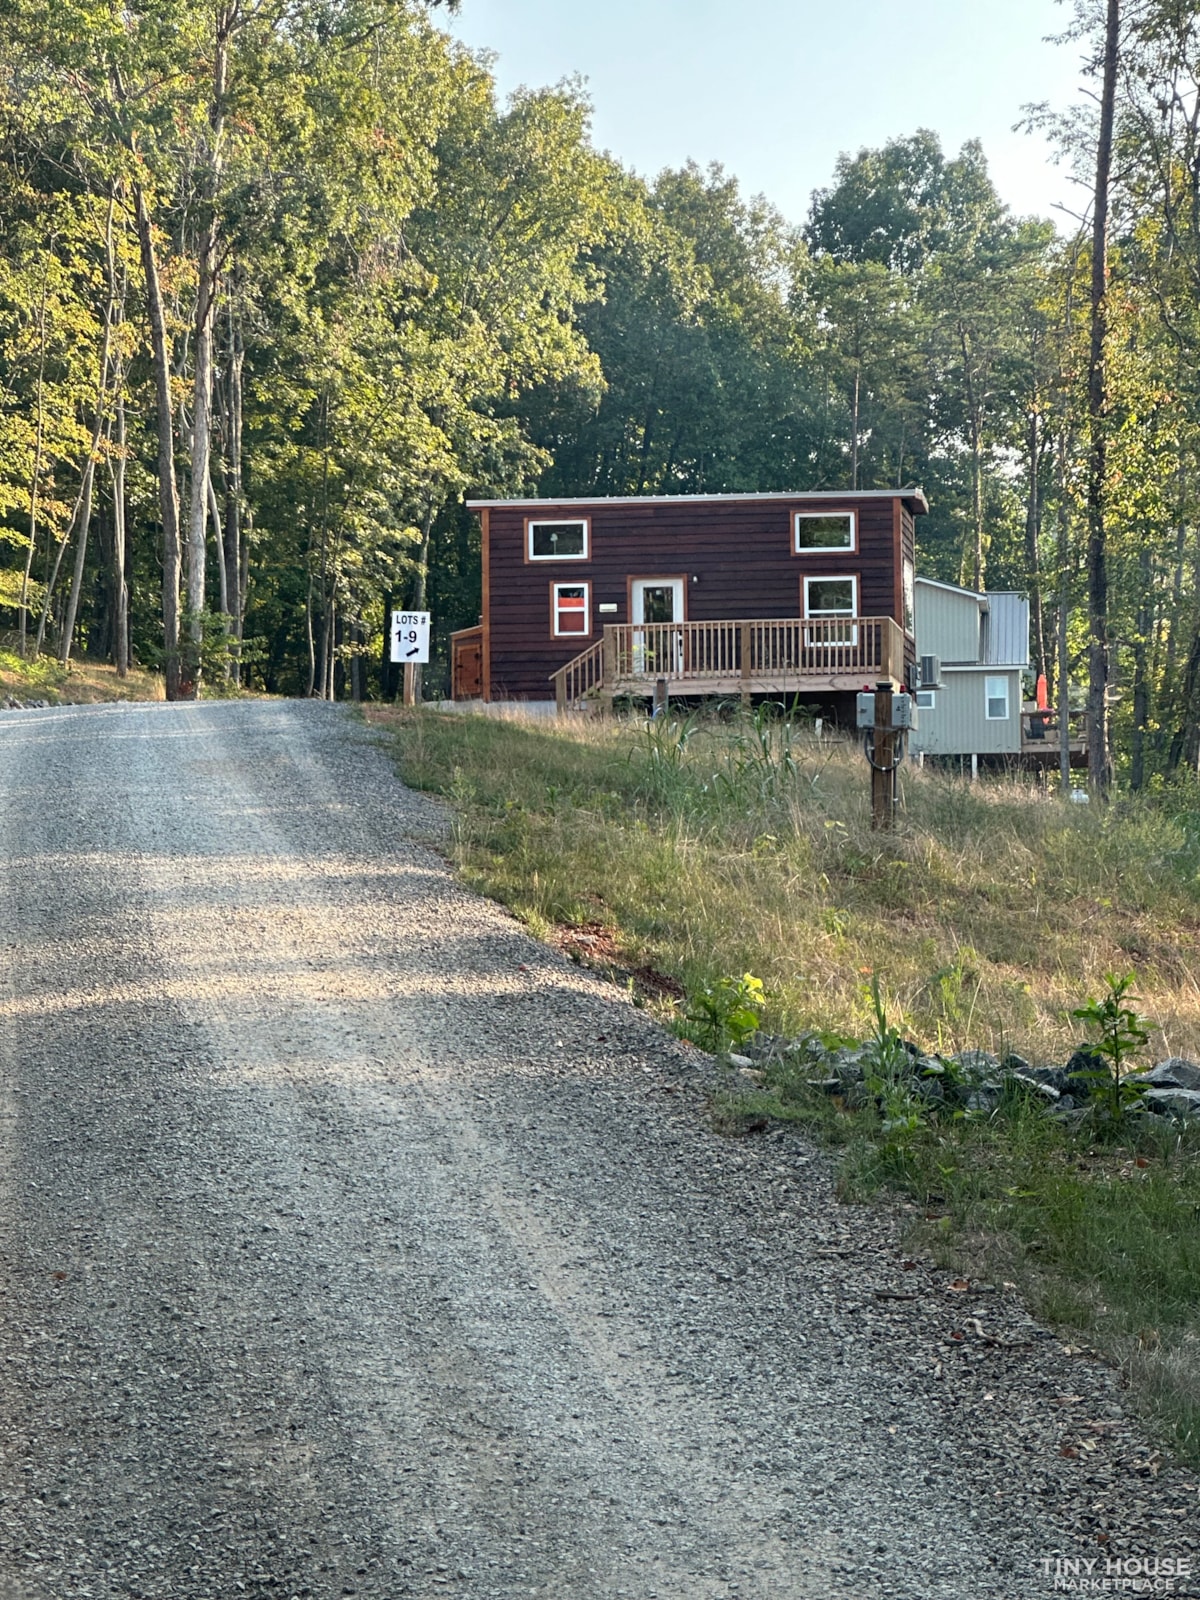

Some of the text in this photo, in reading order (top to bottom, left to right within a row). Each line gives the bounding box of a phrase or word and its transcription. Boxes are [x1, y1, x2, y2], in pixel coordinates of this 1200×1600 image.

[396, 615, 426, 625] LOTS #
[395, 630, 417, 643] 1-9
